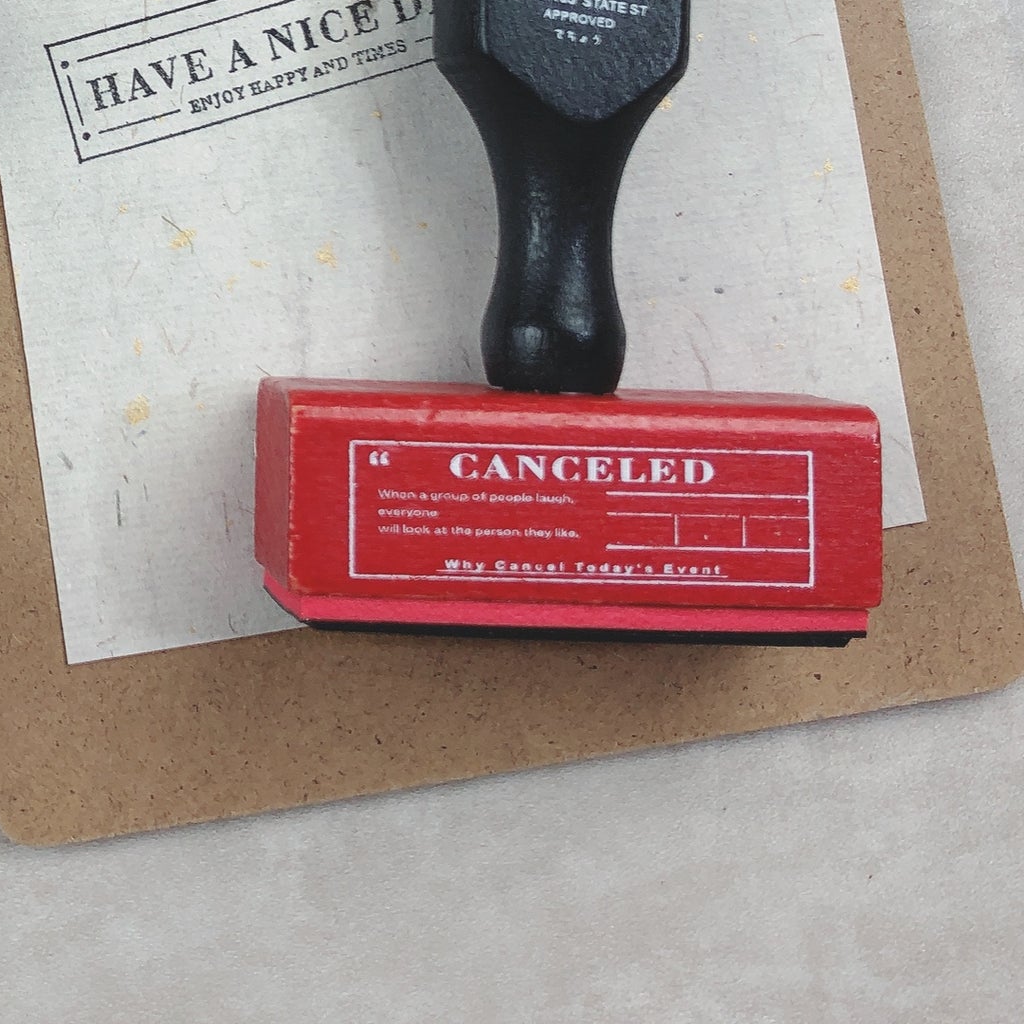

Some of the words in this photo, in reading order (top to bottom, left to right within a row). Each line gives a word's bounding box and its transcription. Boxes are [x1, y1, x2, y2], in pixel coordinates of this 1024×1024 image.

[543, 8, 616, 29] APPROVED
[629, 3, 649, 18] ST
[86, 49, 214, 111] HAVE
[228, 38, 258, 74] A
[263, 0, 380, 61] NICE
[190, 85, 246, 114] ENJOY
[247, 66, 310, 96] HAPPY
[313, 55, 348, 78] AND
[351, 38, 408, 68] TIMES
[449, 452, 715, 484] CANCELED
[378, 488, 416, 501] When
[419, 492, 427, 500] a
[430, 492, 469, 503] group
[472, 490, 488, 502] of
[490, 492, 533, 504] people
[378, 508, 438, 518] everyone
[378, 524, 400, 534] will
[402, 524, 430, 534] look
[434, 526, 448, 535] at
[451, 526, 472, 536] the
[475, 528, 520, 538] person
[524, 527, 553, 540] they
[444, 559, 485, 573] Why
[495, 560, 565, 572] Cancel
[663, 563, 721, 574] Event
